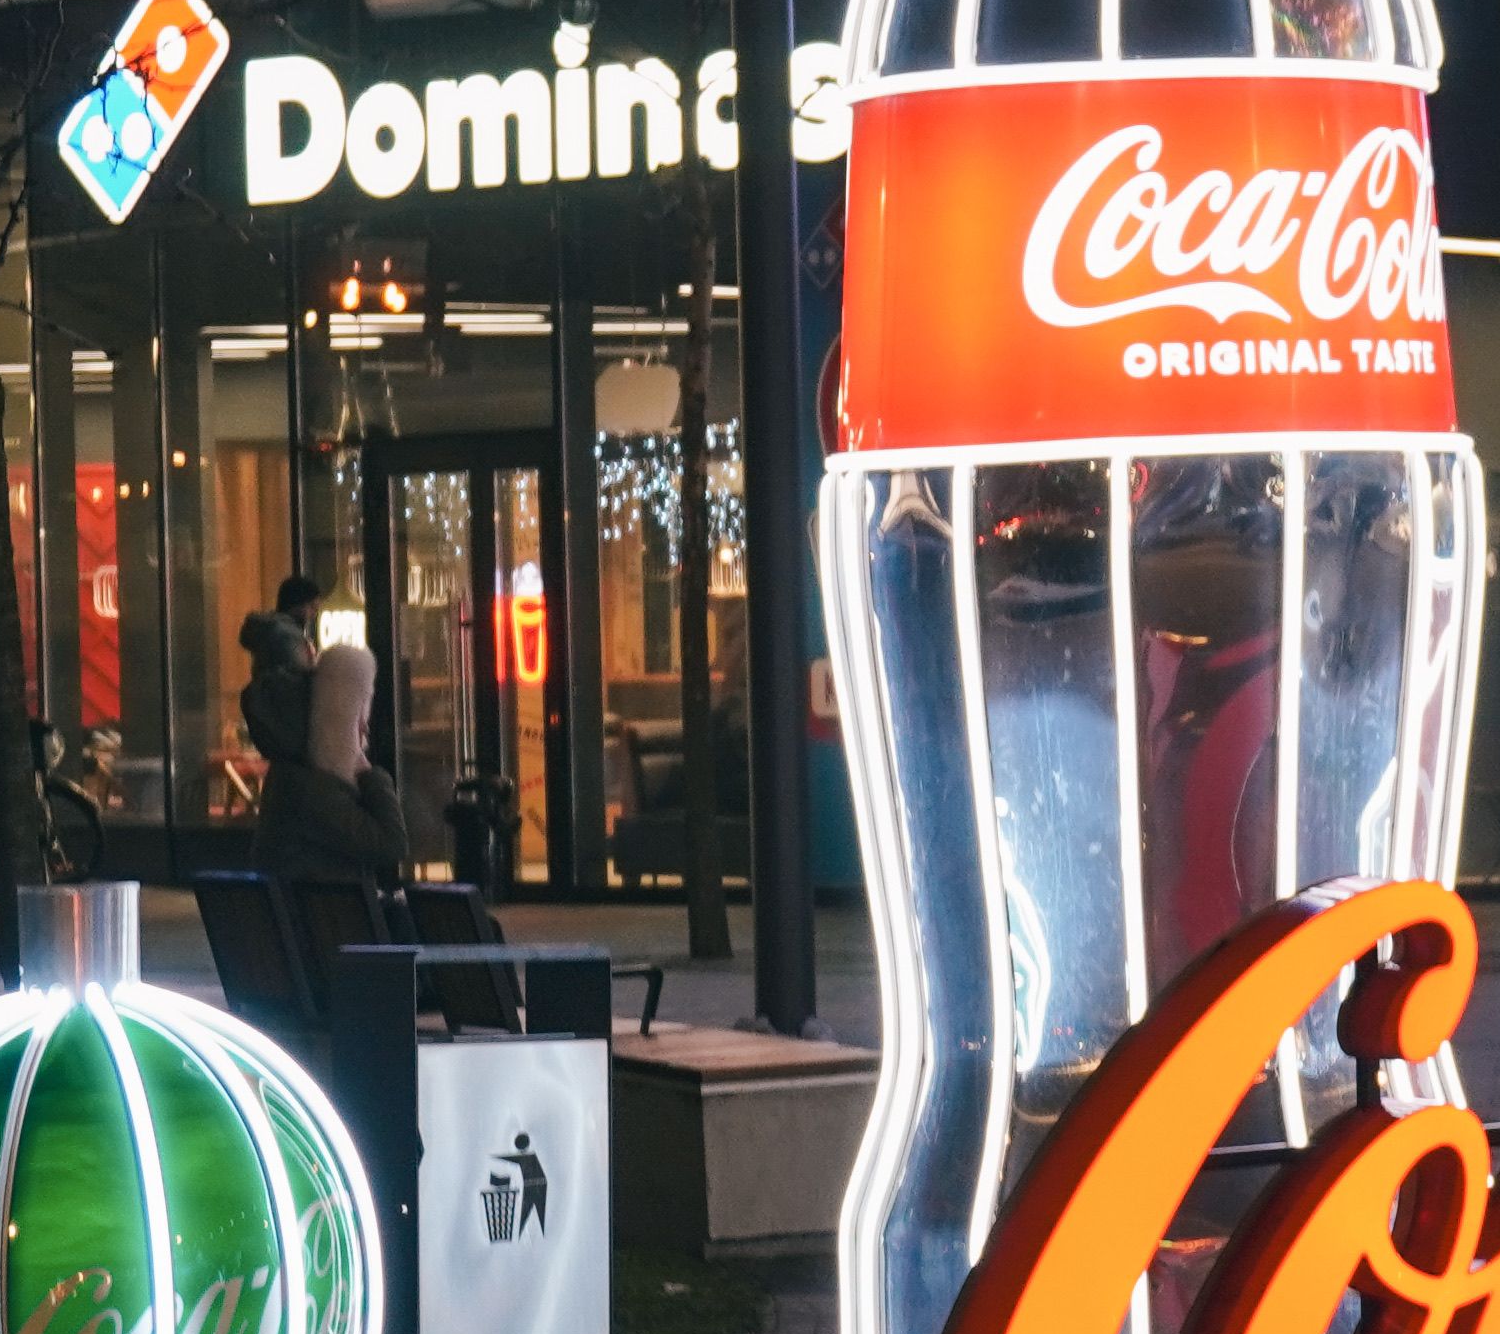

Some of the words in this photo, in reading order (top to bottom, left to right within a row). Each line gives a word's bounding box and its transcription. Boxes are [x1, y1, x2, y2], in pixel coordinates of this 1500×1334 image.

[1022, 124, 1445, 328] Coca-Cola
[1122, 339, 1341, 379] ORIGINAL
[1352, 339, 1436, 376] TASTE
